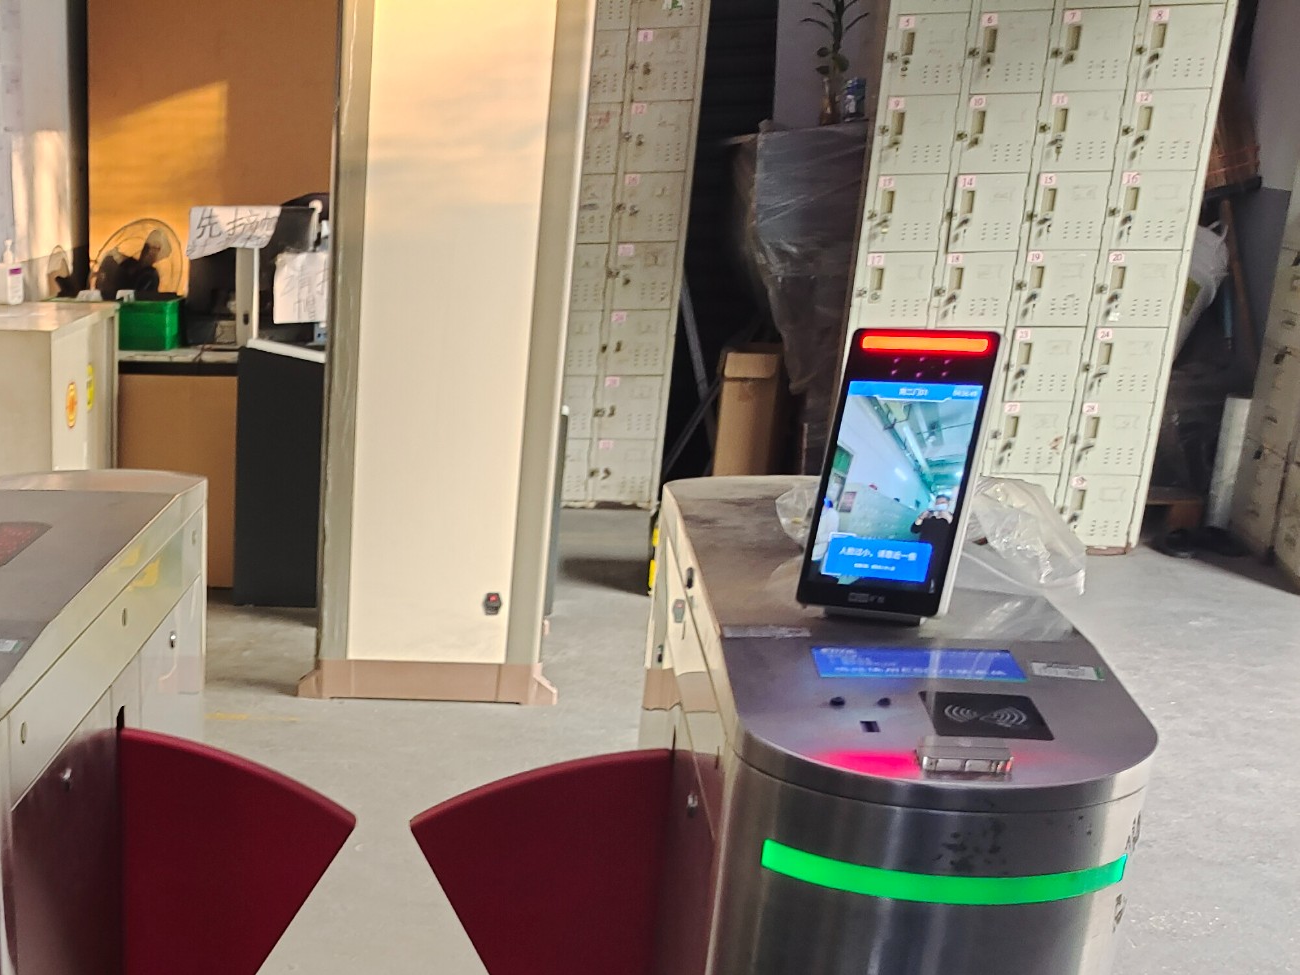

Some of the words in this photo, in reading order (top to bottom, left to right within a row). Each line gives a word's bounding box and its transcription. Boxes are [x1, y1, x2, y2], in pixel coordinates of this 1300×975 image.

[962, 177, 974, 188] 14
[1044, 175, 1054, 185] 15
[1126, 173, 1140, 184] 16
[871, 254, 883, 265] 17
[1031, 253, 1041, 262] 19
[1112, 252, 1123, 262] 20
[1019, 330, 1029, 339] 23
[1099, 330, 1111, 339] 24
[1007, 404, 1018, 412] 27
